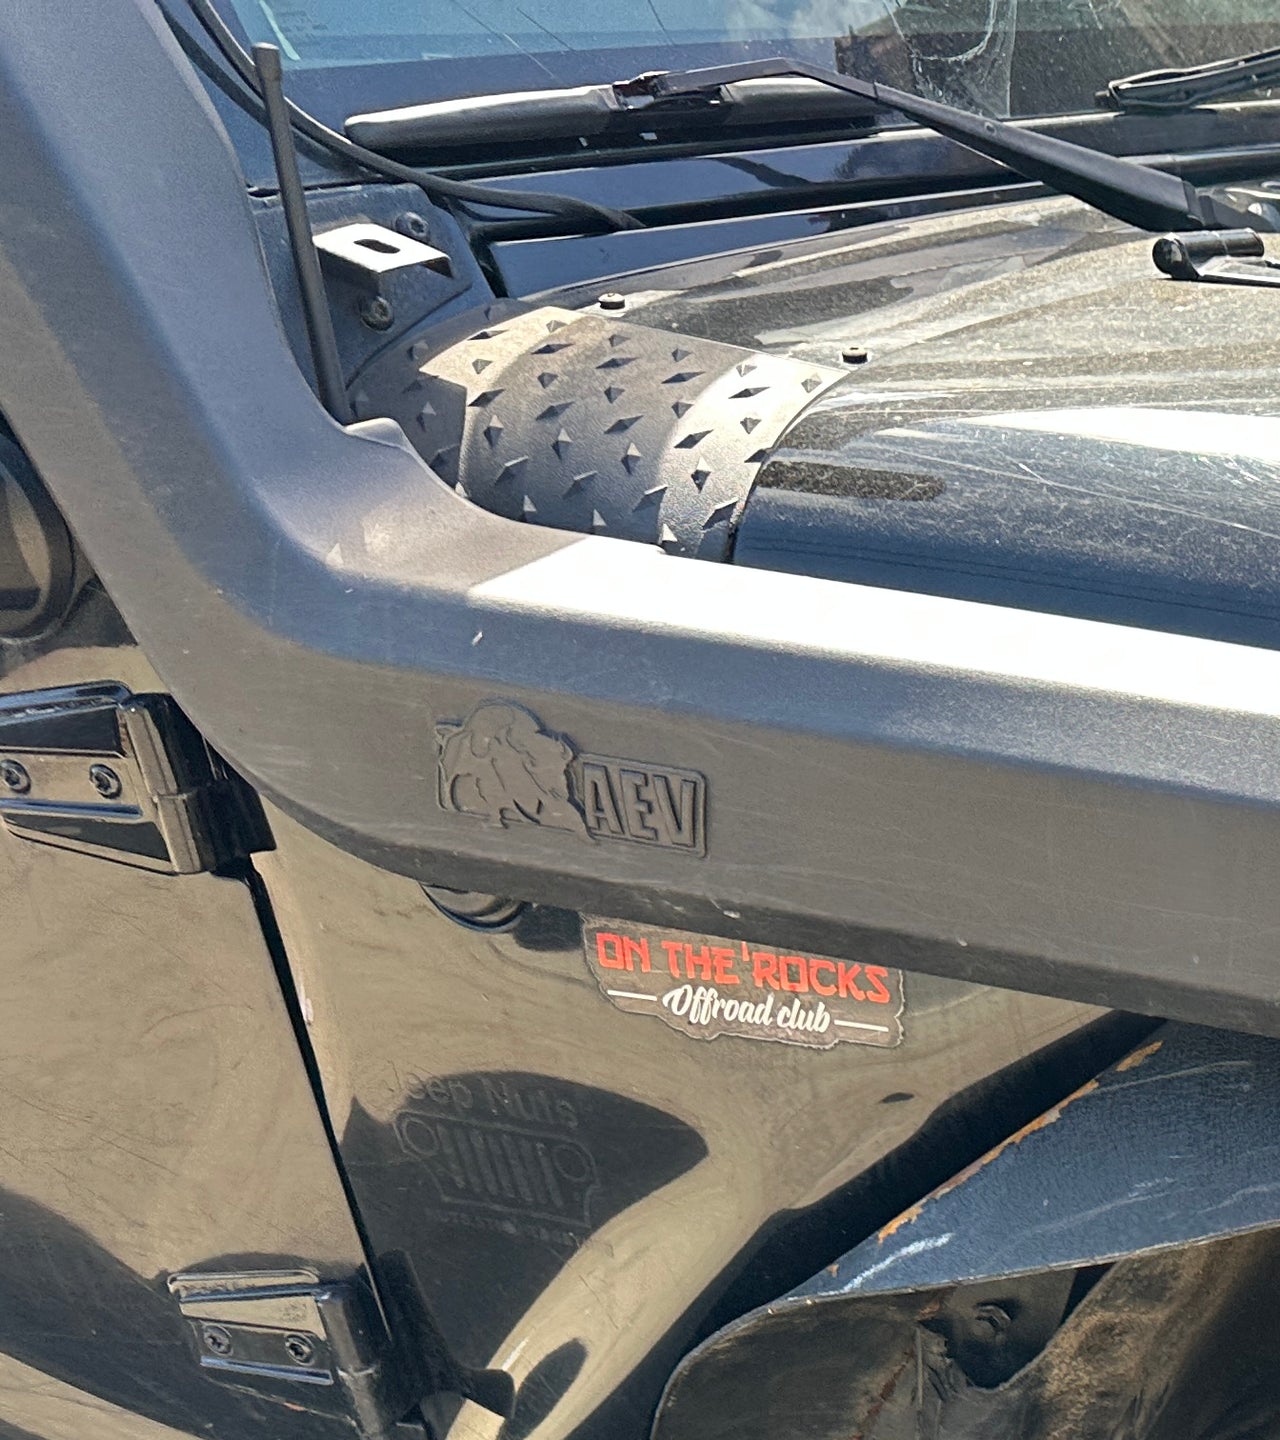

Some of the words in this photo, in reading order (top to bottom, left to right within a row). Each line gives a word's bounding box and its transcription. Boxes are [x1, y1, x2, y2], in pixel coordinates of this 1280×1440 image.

[583, 762, 697, 848] AEV
[596, 932, 650, 973] ON
[661, 940, 740, 985] THE
[663, 984, 773, 1026] Offroad
[776, 997, 830, 1033] club
